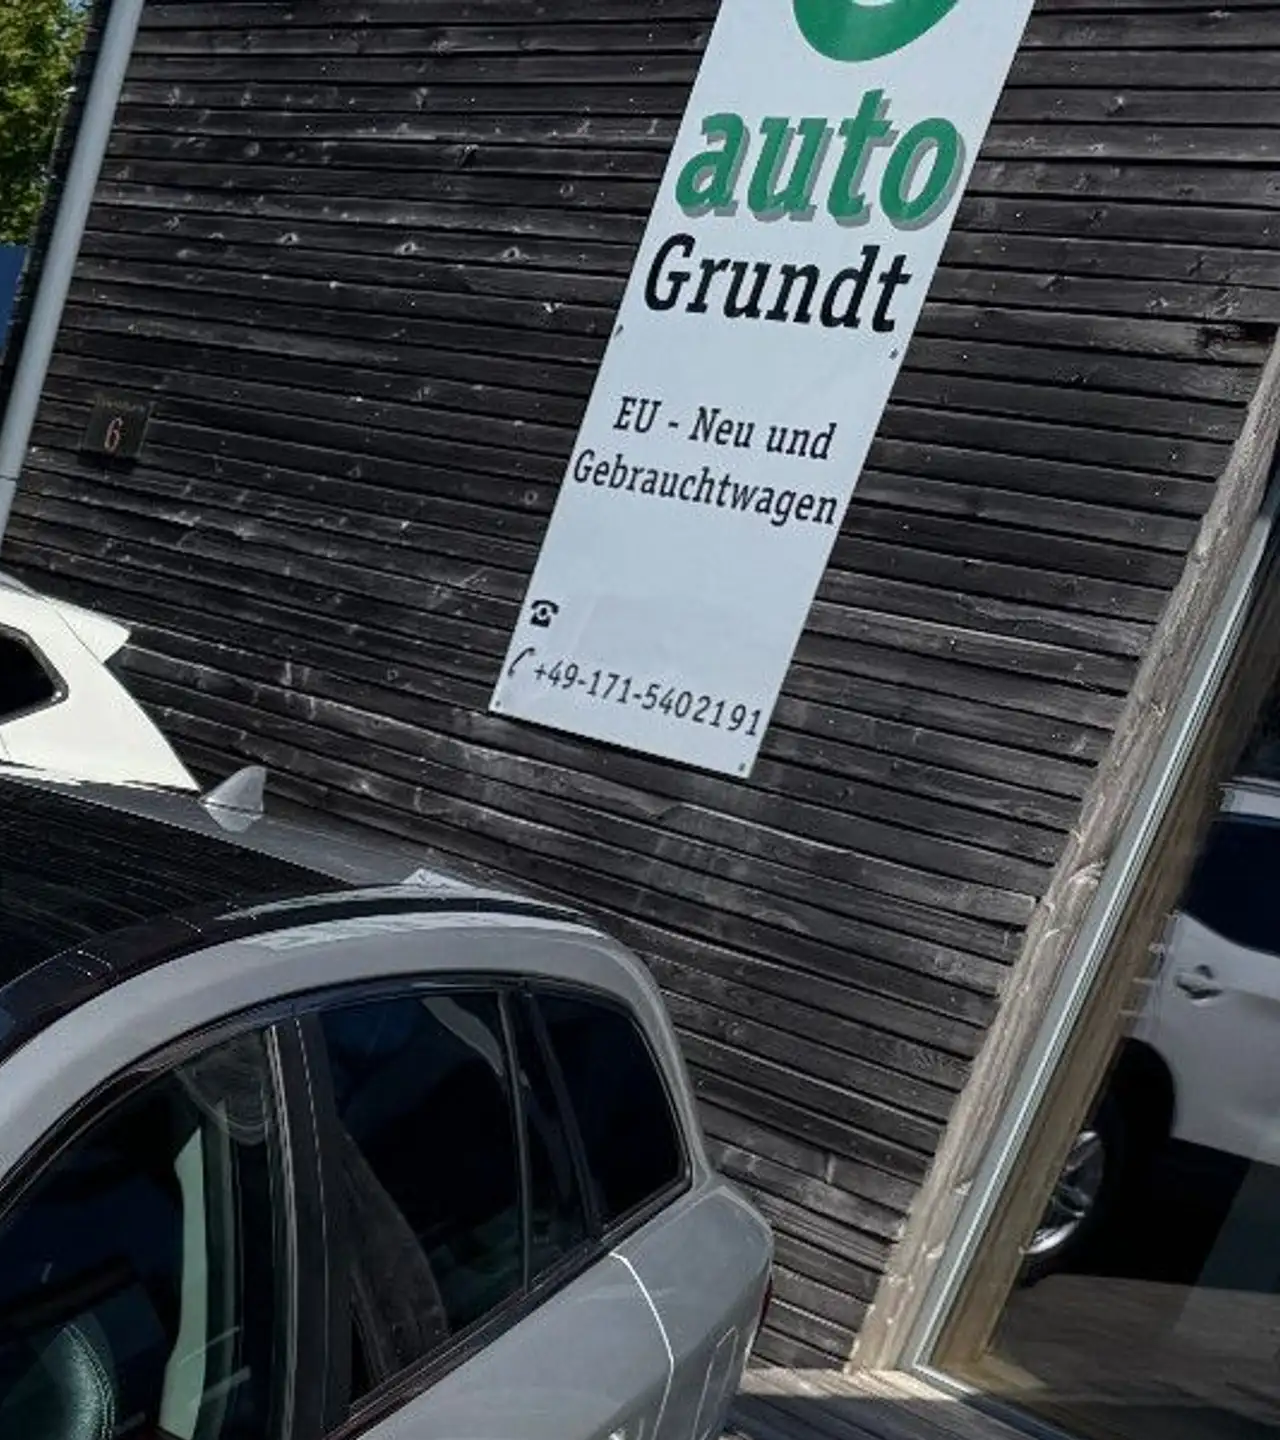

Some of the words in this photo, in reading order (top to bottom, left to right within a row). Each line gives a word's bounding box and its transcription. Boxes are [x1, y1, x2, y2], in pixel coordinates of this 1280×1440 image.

[675, 88, 967, 231] auto
[644, 233, 913, 333] Grundt
[103, 416, 124, 454] 6
[612, 396, 662, 433] EU
[688, 406, 756, 449] Neu
[765, 422, 838, 461] und
[573, 448, 838, 527] Gebrauchtwagen
[533, 660, 762, 736] +49-171-5402191
